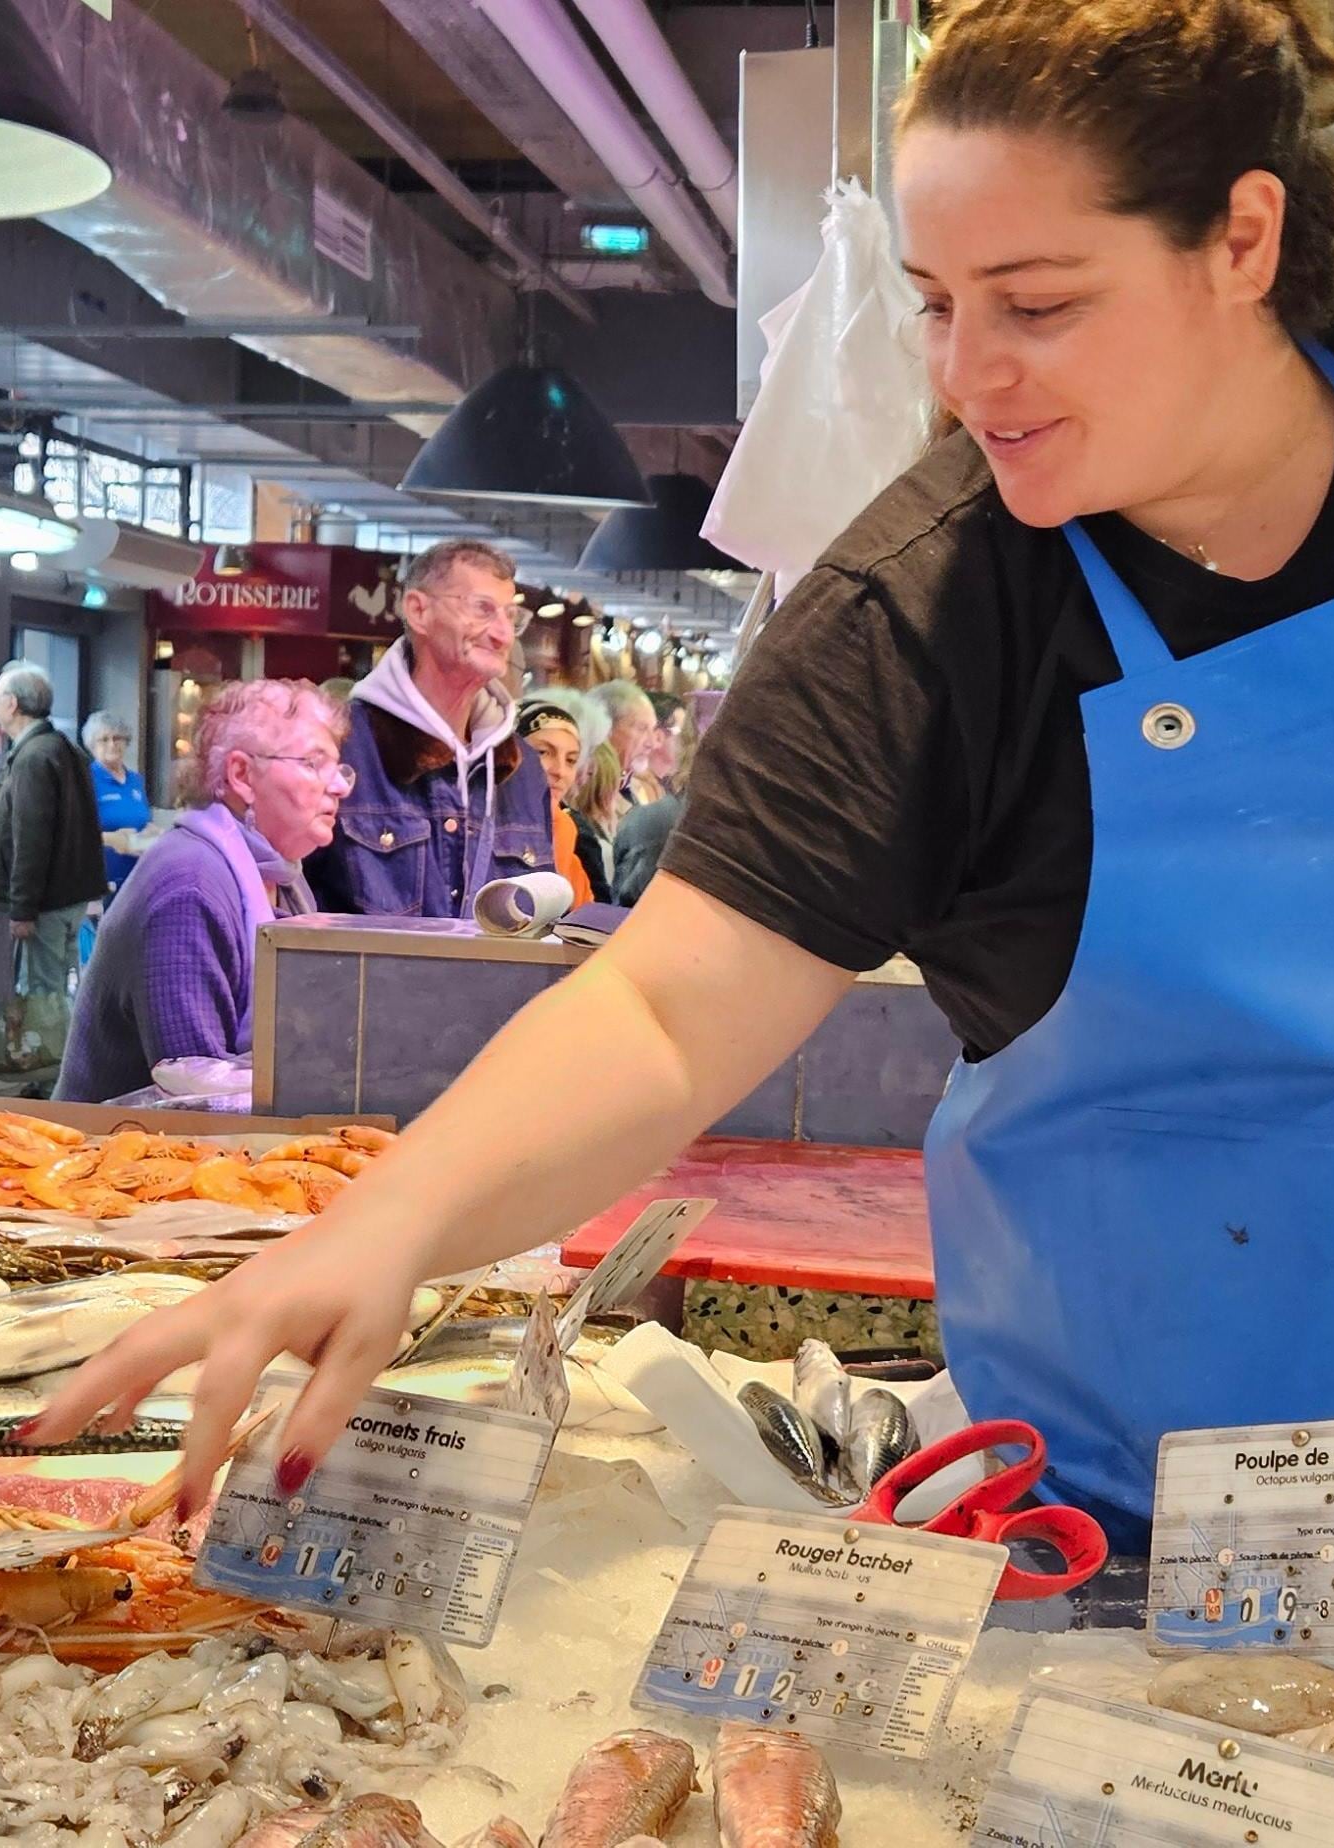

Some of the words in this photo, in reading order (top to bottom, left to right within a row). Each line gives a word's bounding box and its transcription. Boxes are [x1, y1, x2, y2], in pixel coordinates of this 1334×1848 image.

[173, 577, 320, 610] ROTISSERIE
[355, 1438, 385, 1452] Loligo
[387, 1443, 427, 1460] vulgaris
[424, 1426, 466, 1450] frais
[1235, 1450, 1299, 1472] Poulpe
[1304, 1447, 1329, 1465] de
[1256, 1474, 1297, 1486] Octopus
[1297, 1527, 1314, 1537] Type
[775, 1539, 844, 1564] Rouget
[847, 1548, 914, 1574] barbet
[788, 1562, 822, 1577] Mullus
[817, 1617, 833, 1629] Type
[875, 1627, 900, 1639] pêche
[1178, 1757, 1259, 1797] Merlu
[1131, 1774, 1210, 1808] Merluccius
[1212, 1799, 1294, 1832] merluccius
